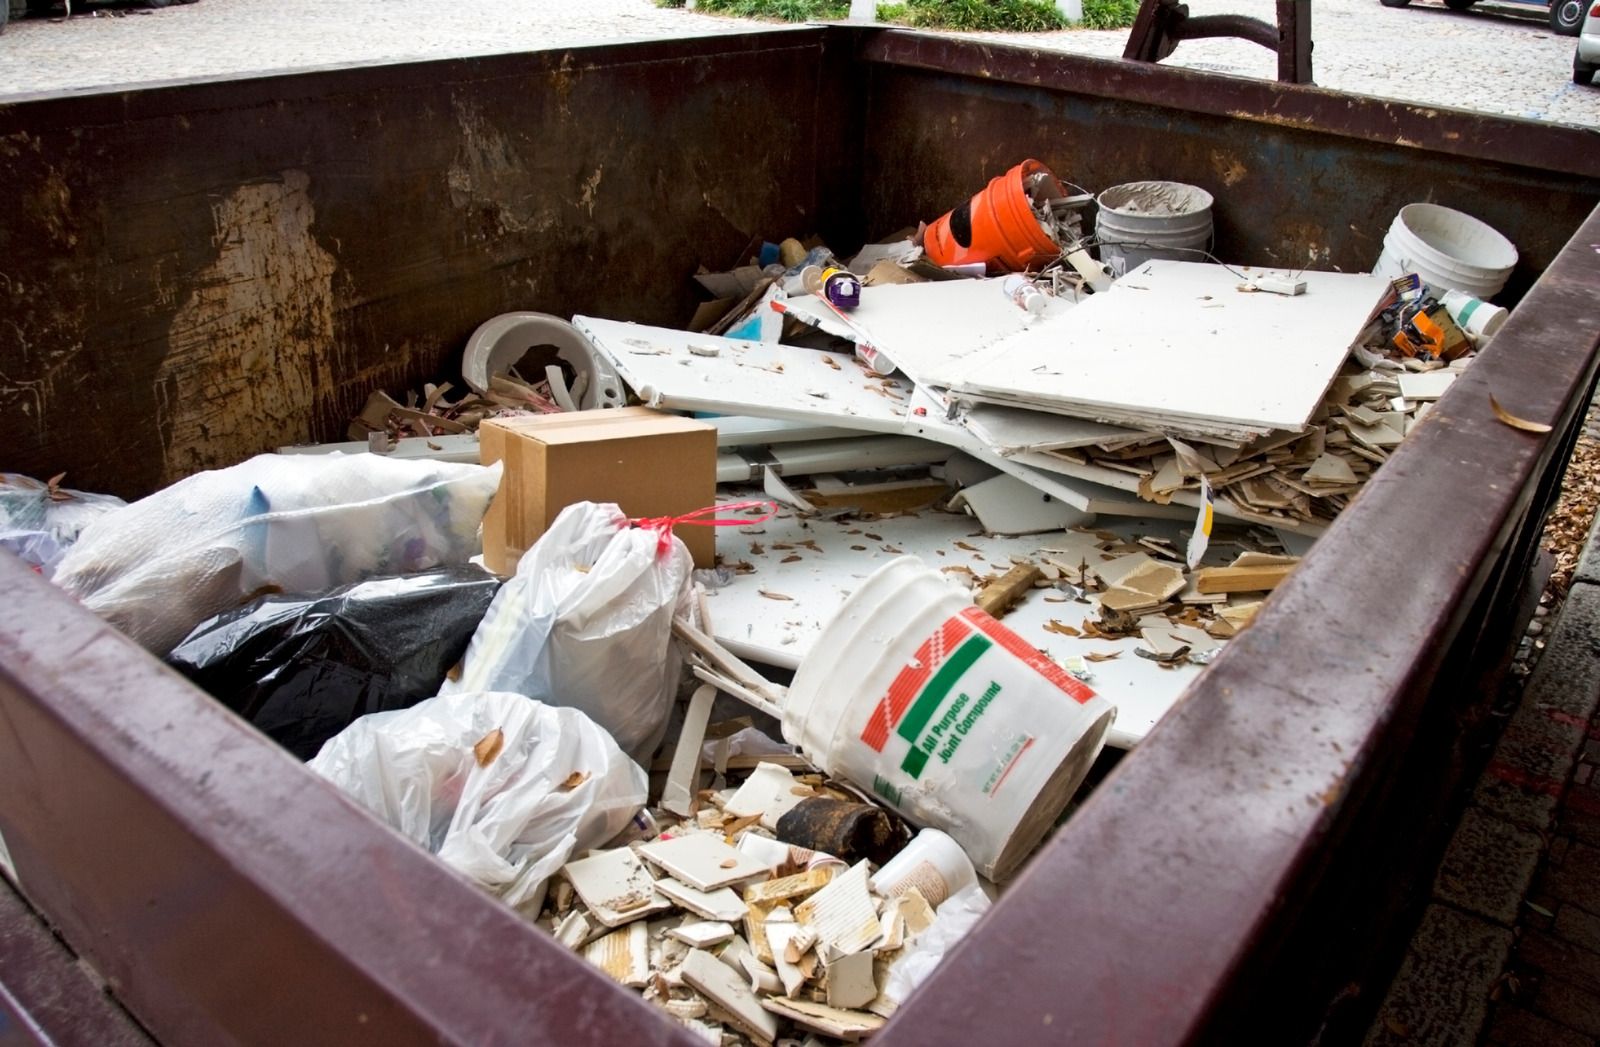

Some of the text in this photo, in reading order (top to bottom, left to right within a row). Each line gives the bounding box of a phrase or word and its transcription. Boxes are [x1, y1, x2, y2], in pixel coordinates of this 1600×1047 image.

[922, 692, 970, 754] All Purpose
[937, 680, 1002, 764] Joint Compound
